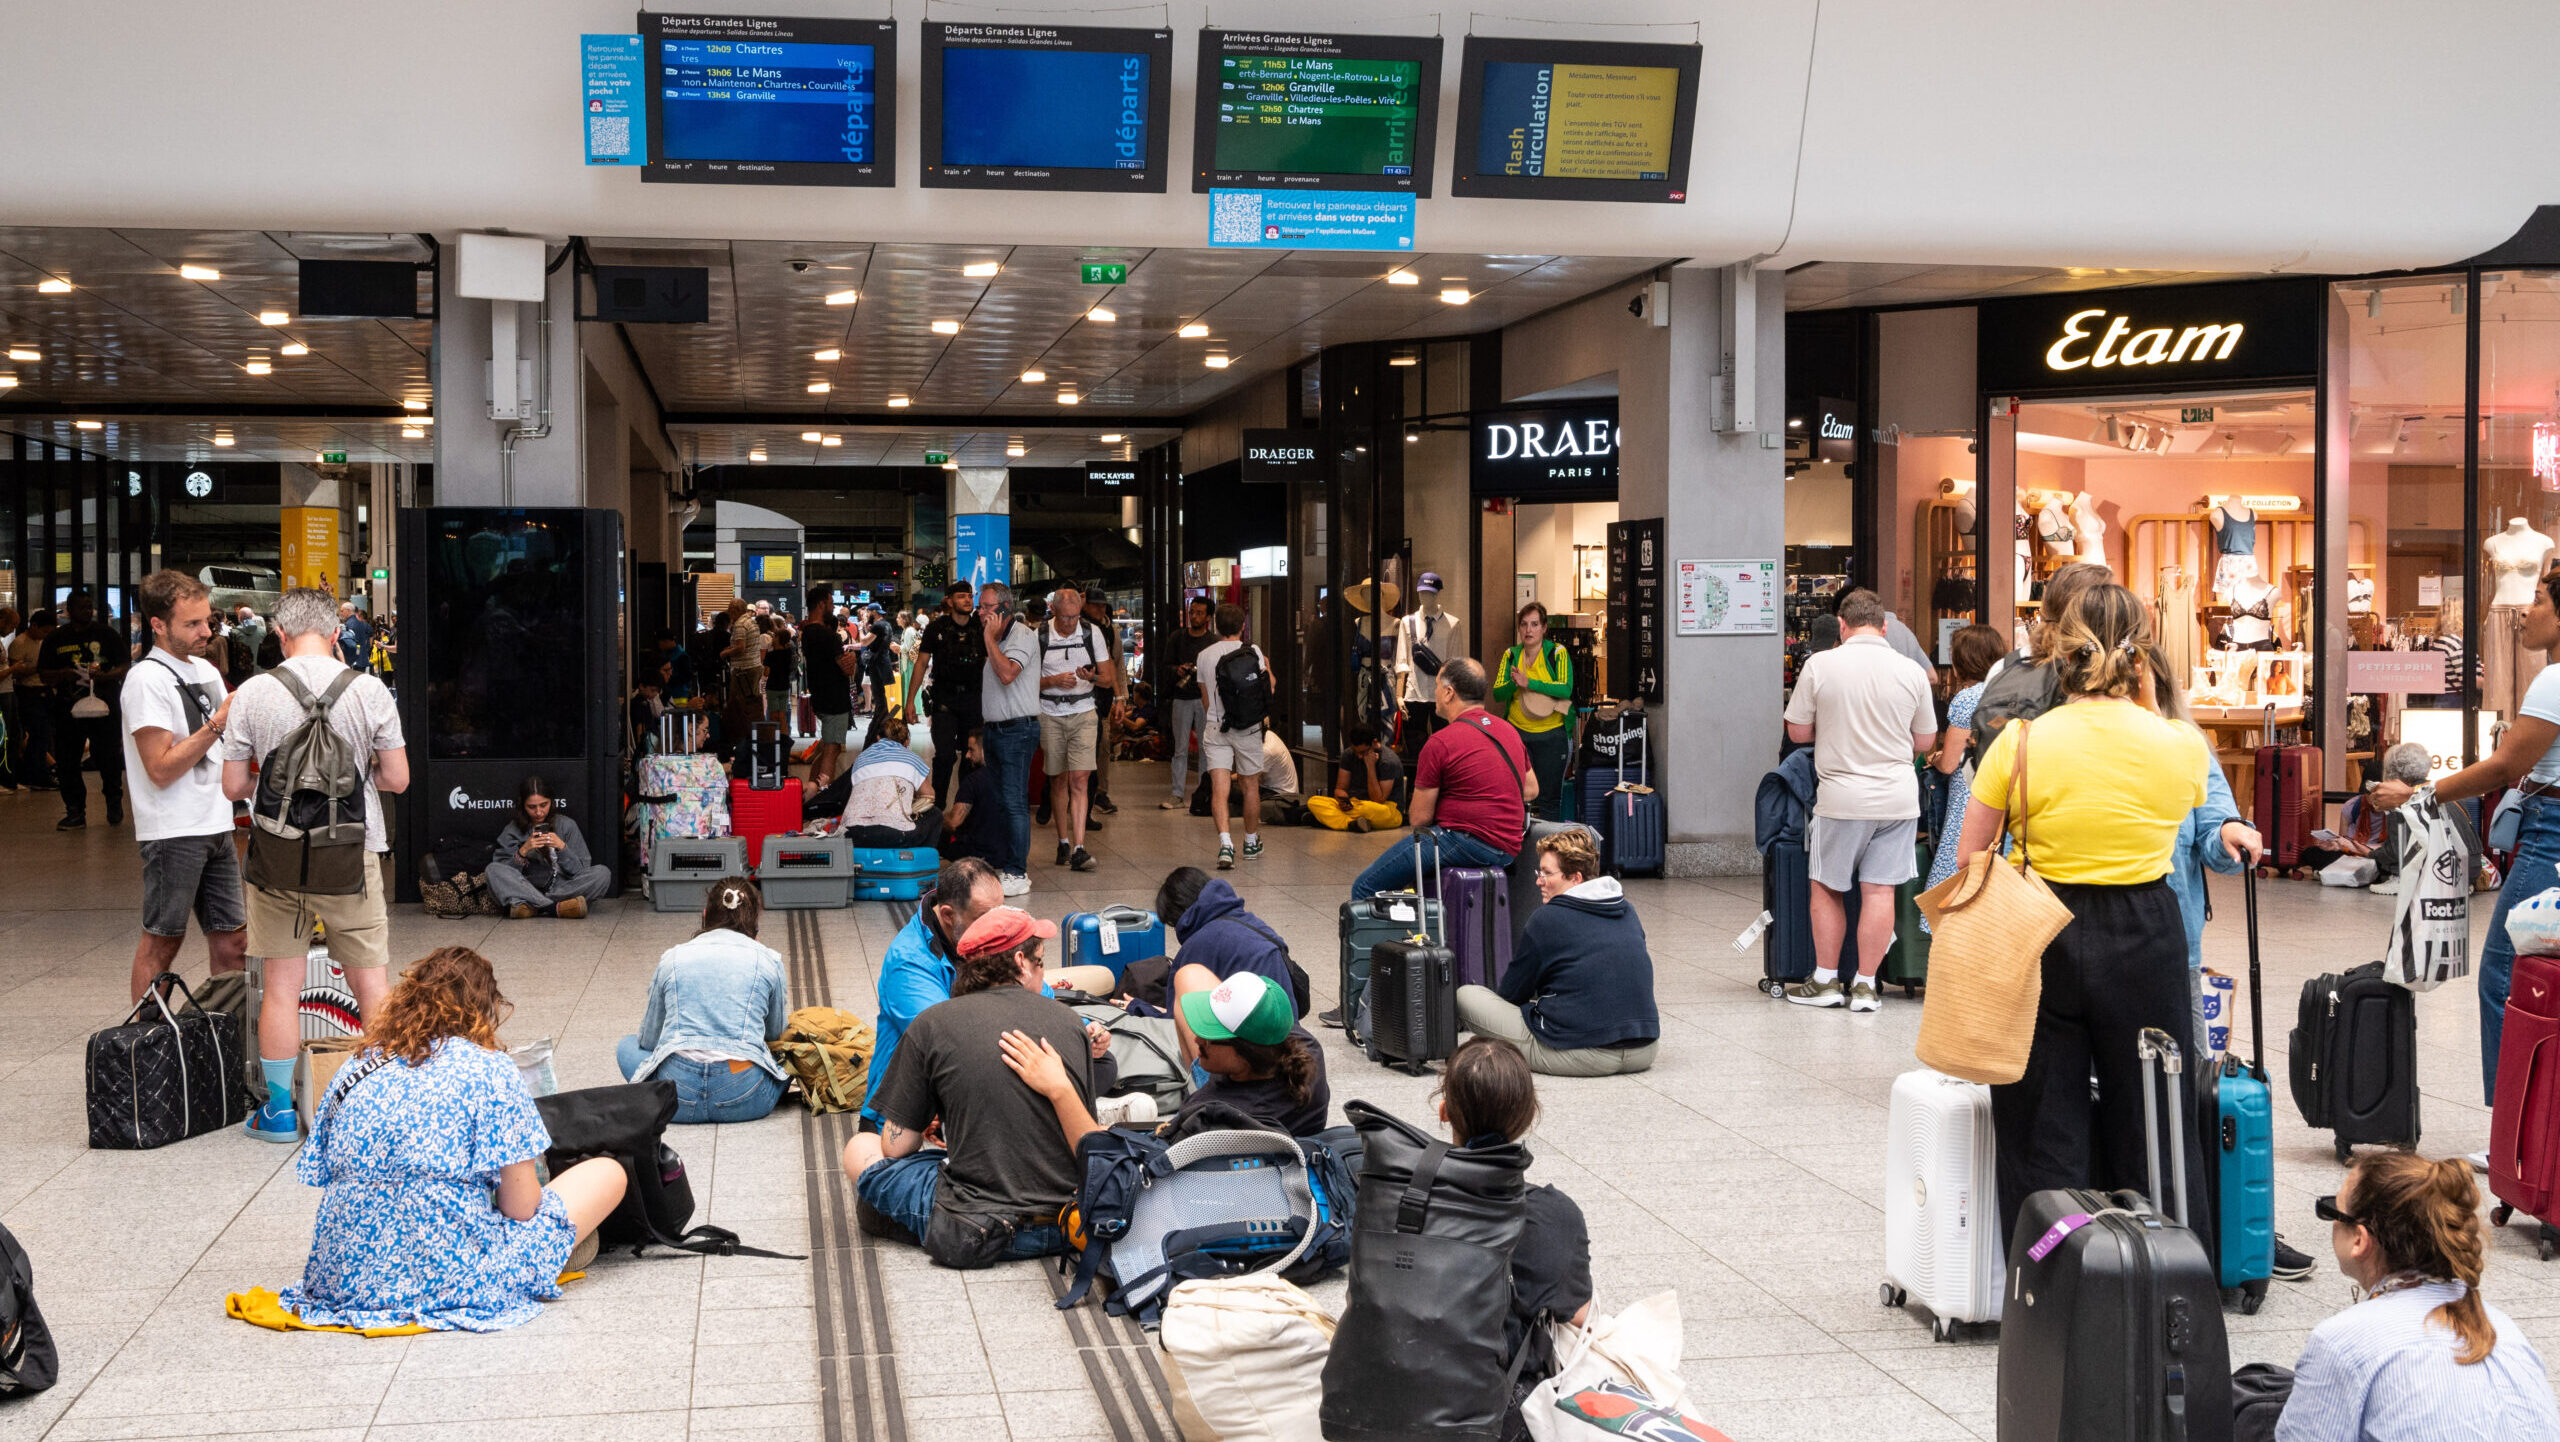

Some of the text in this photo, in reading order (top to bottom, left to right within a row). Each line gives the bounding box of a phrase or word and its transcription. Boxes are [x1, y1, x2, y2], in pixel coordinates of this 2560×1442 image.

[662, 16, 778, 29] Départs Grandes Lignes
[945, 26, 1057, 38] Départs Grandes Lignes
[1223, 34, 1333, 46] Arrivées Grandes Lignes
[706, 43, 783, 55] 12h09 Chartres
[1262, 61, 1286, 69] 11h53
[1291, 59, 1303, 69] Le
[1306, 60, 1333, 70] Mans
[707, 67, 781, 78] 13h06 Le Mans
[1239, 70, 1292, 79] erté-Bernard
[1300, 71, 1373, 82] Nogent-le-Rotrou
[1380, 74, 1389, 82] La
[709, 79, 756, 88] Maintenon
[764, 80, 801, 89] Chartres
[1261, 83, 1285, 91] 12h06
[1289, 82, 1335, 93] Granville
[589, 88, 613, 96] poche
[737, 91, 776, 100] Granville
[1246, 92, 1395, 105] Granville Villedieu-les-Poêles Vire
[841, 61, 869, 162] départs
[1116, 57, 1143, 157] départs
[1260, 105, 1282, 113] 12h50
[1288, 105, 1323, 114] Chartres
[1260, 116, 1281, 124] 13h53
[1287, 116, 1297, 124] Le
[1299, 117, 1322, 125] Mans
[1525, 69, 1550, 176] circulation
[1505, 128, 1525, 175] flash
[738, 164, 775, 172] destination
[1267, 200, 1407, 214] Retrouvez les panneaux départs
[1278, 213, 1312, 221] arrivées
[1314, 212, 1337, 222] dans
[1340, 214, 1365, 222] votre
[1367, 214, 1396, 224] poche
[2046, 309, 2244, 370] Etam
[1821, 413, 1854, 440] Etam
[1488, 420, 1620, 459] DRAE
[1249, 448, 1315, 459] DRAEGER
[1549, 468, 1592, 478] PARIS
[2358, 663, 2433, 671] PETITS PRIX
[1593, 727, 1643, 745] shopping
[1594, 742, 1617, 756] bag
[468, 798, 567, 809] MEDIATRTS
[2425, 902, 2453, 917] Foot
